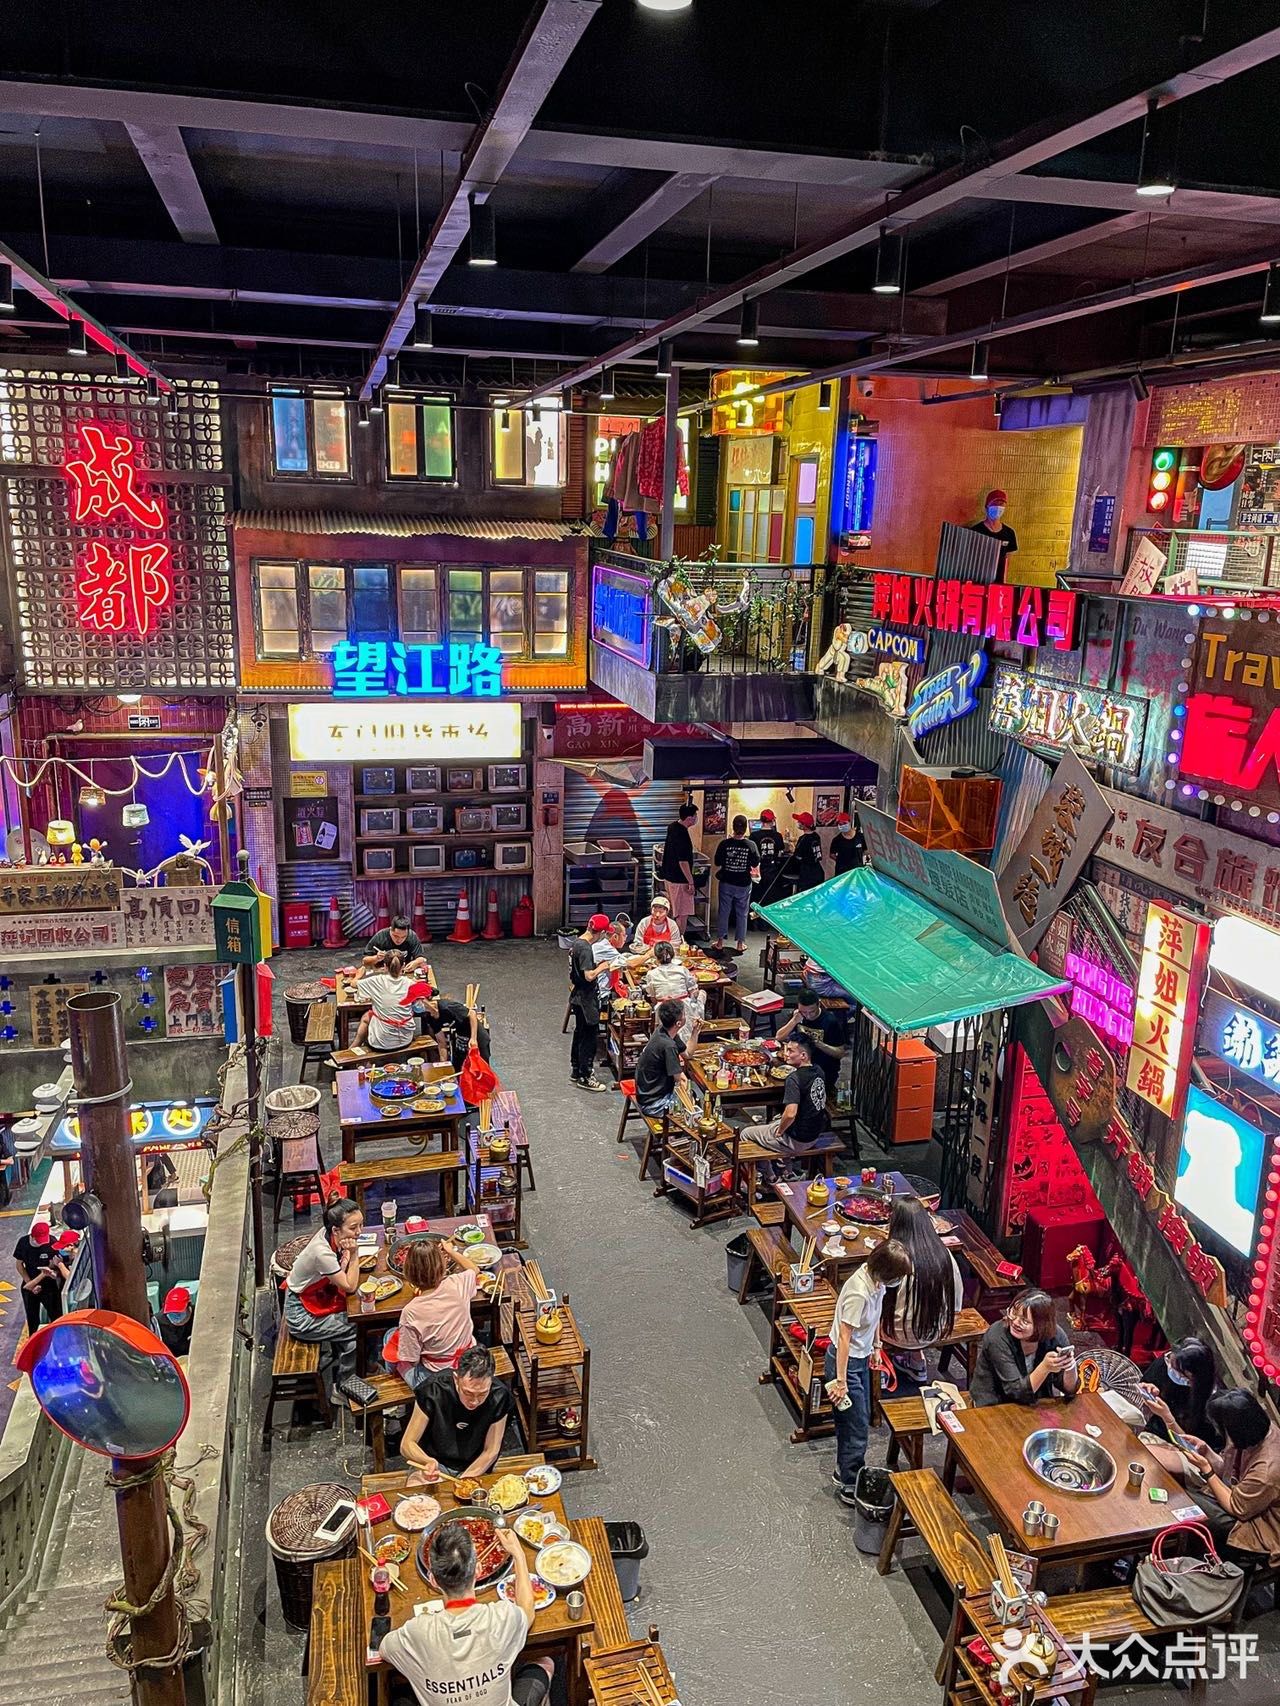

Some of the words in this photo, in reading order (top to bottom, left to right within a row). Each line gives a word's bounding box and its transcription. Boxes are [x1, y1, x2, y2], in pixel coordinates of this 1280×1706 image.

[66, 427, 169, 635] 成都
[867, 628, 918, 661] CAPCOM
[331, 641, 503, 697] 望江路
[567, 711, 625, 738] 高新
[566, 740, 591, 750] GAO
[600, 739, 620, 750] XIN
[225, 917, 242, 953] 信箱
[425, 1663, 505, 1694] ESSENTIALS
[446, 1696, 462, 1704] FEAR
[464, 1693, 473, 1701] OF
[476, 1688, 488, 1698] GOD
